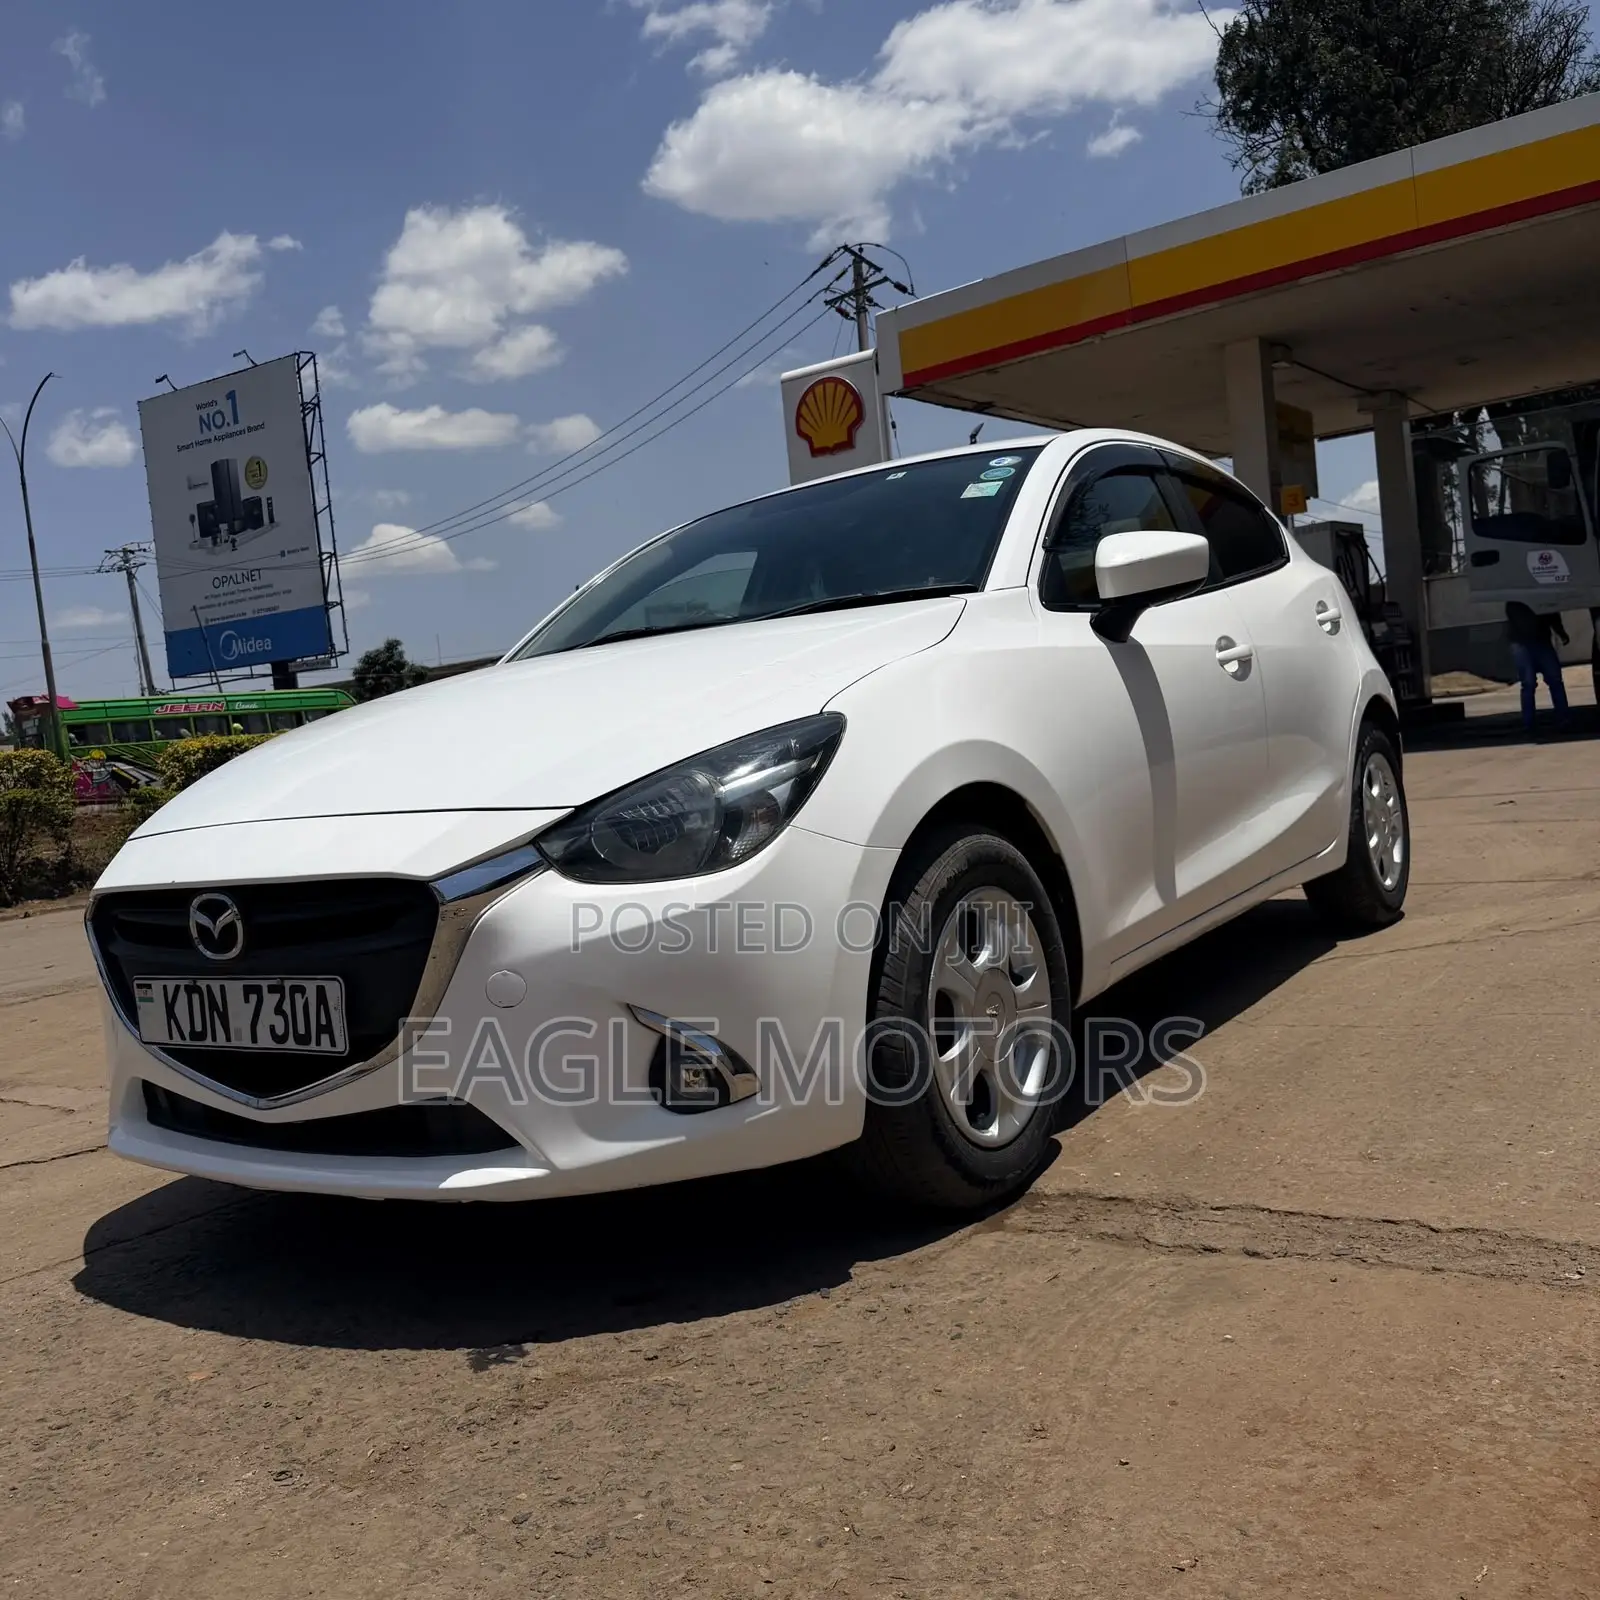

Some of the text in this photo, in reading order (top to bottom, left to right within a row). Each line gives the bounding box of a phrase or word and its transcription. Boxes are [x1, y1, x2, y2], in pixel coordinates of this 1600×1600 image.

[196, 400, 218, 411] World's
[198, 389, 239, 434] NO.1
[177, 421, 265, 452] Smart Home Appliances Brand
[212, 568, 263, 589] OPALNET
[225, 633, 272, 658] Midea
[163, 984, 232, 1043] KDN
[243, 984, 337, 1048] 730A
